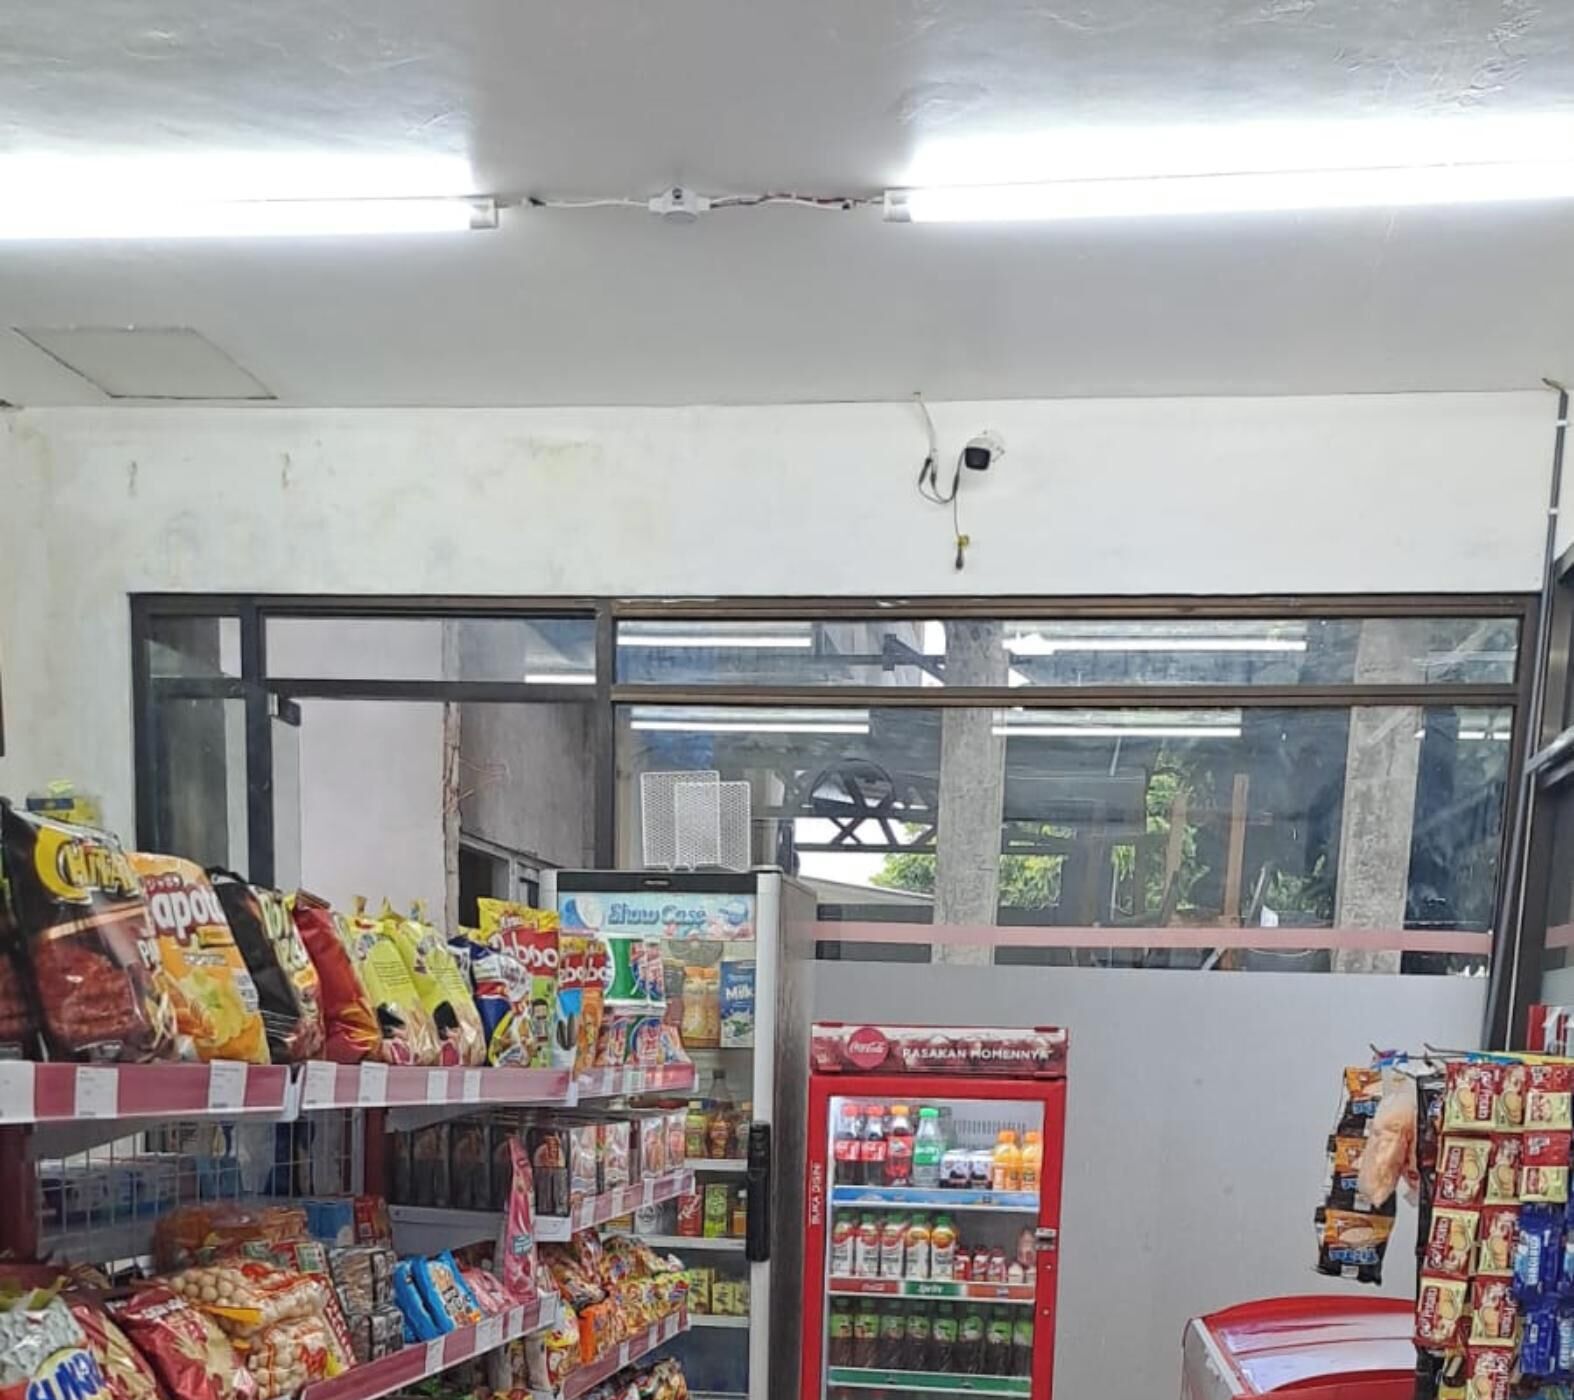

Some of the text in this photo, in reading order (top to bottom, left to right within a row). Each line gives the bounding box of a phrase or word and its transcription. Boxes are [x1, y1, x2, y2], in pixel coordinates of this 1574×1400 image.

[608, 902, 707, 926] Show Case
[902, 1048, 967, 1060] RASAKAN
